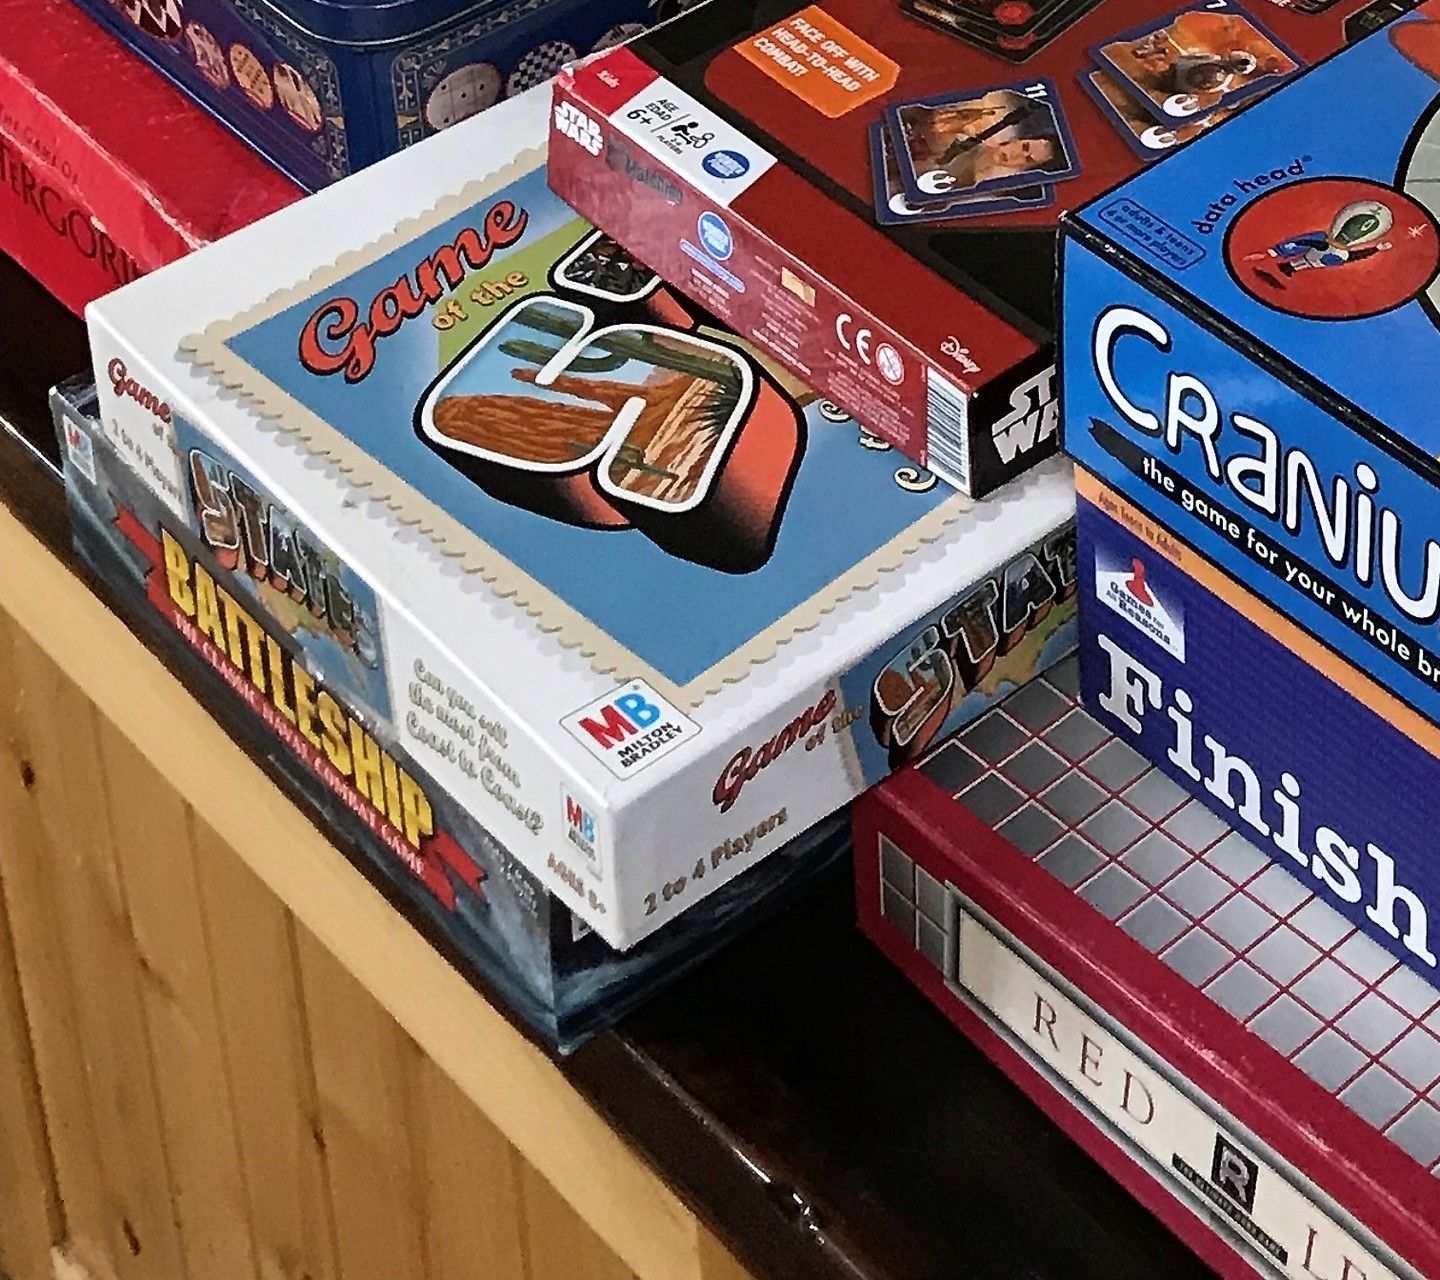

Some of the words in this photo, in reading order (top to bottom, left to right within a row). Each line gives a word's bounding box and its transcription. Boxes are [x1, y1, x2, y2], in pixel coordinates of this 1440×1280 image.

[790, 17, 826, 43] FACE
[820, 40, 850, 58] OFF
[844, 56, 881, 83] WITH
[554, 100, 602, 133] STAR
[626, 108, 652, 126] 6+
[645, 102, 673, 121] EDAD
[657, 98, 680, 113] AGE
[555, 113, 604, 157] WARS
[1191, 193, 1238, 235] data
[299, 200, 529, 383] Game
[430, 297, 468, 333] of
[470, 270, 531, 311] the
[107, 356, 172, 424] Game
[1142, 457, 1176, 495] the
[1181, 486, 1242, 541] game
[1246, 528, 1280, 570] for
[1283, 559, 1337, 609] your
[1342, 602, 1412, 663] whole
[161, 527, 434, 849] BATTLESHIP
[413, 657, 445, 696] Can
[578, 693, 662, 750] MB
[617, 721, 676, 759] MILTON
[620, 725, 683, 768] BRADLEY
[711, 689, 838, 814] Game
[1097, 632, 1439, 968] Finish
[644, 893, 658, 917] 2
[662, 876, 688, 901] to
[692, 858, 706, 880] 4
[711, 807, 789, 870] Players
